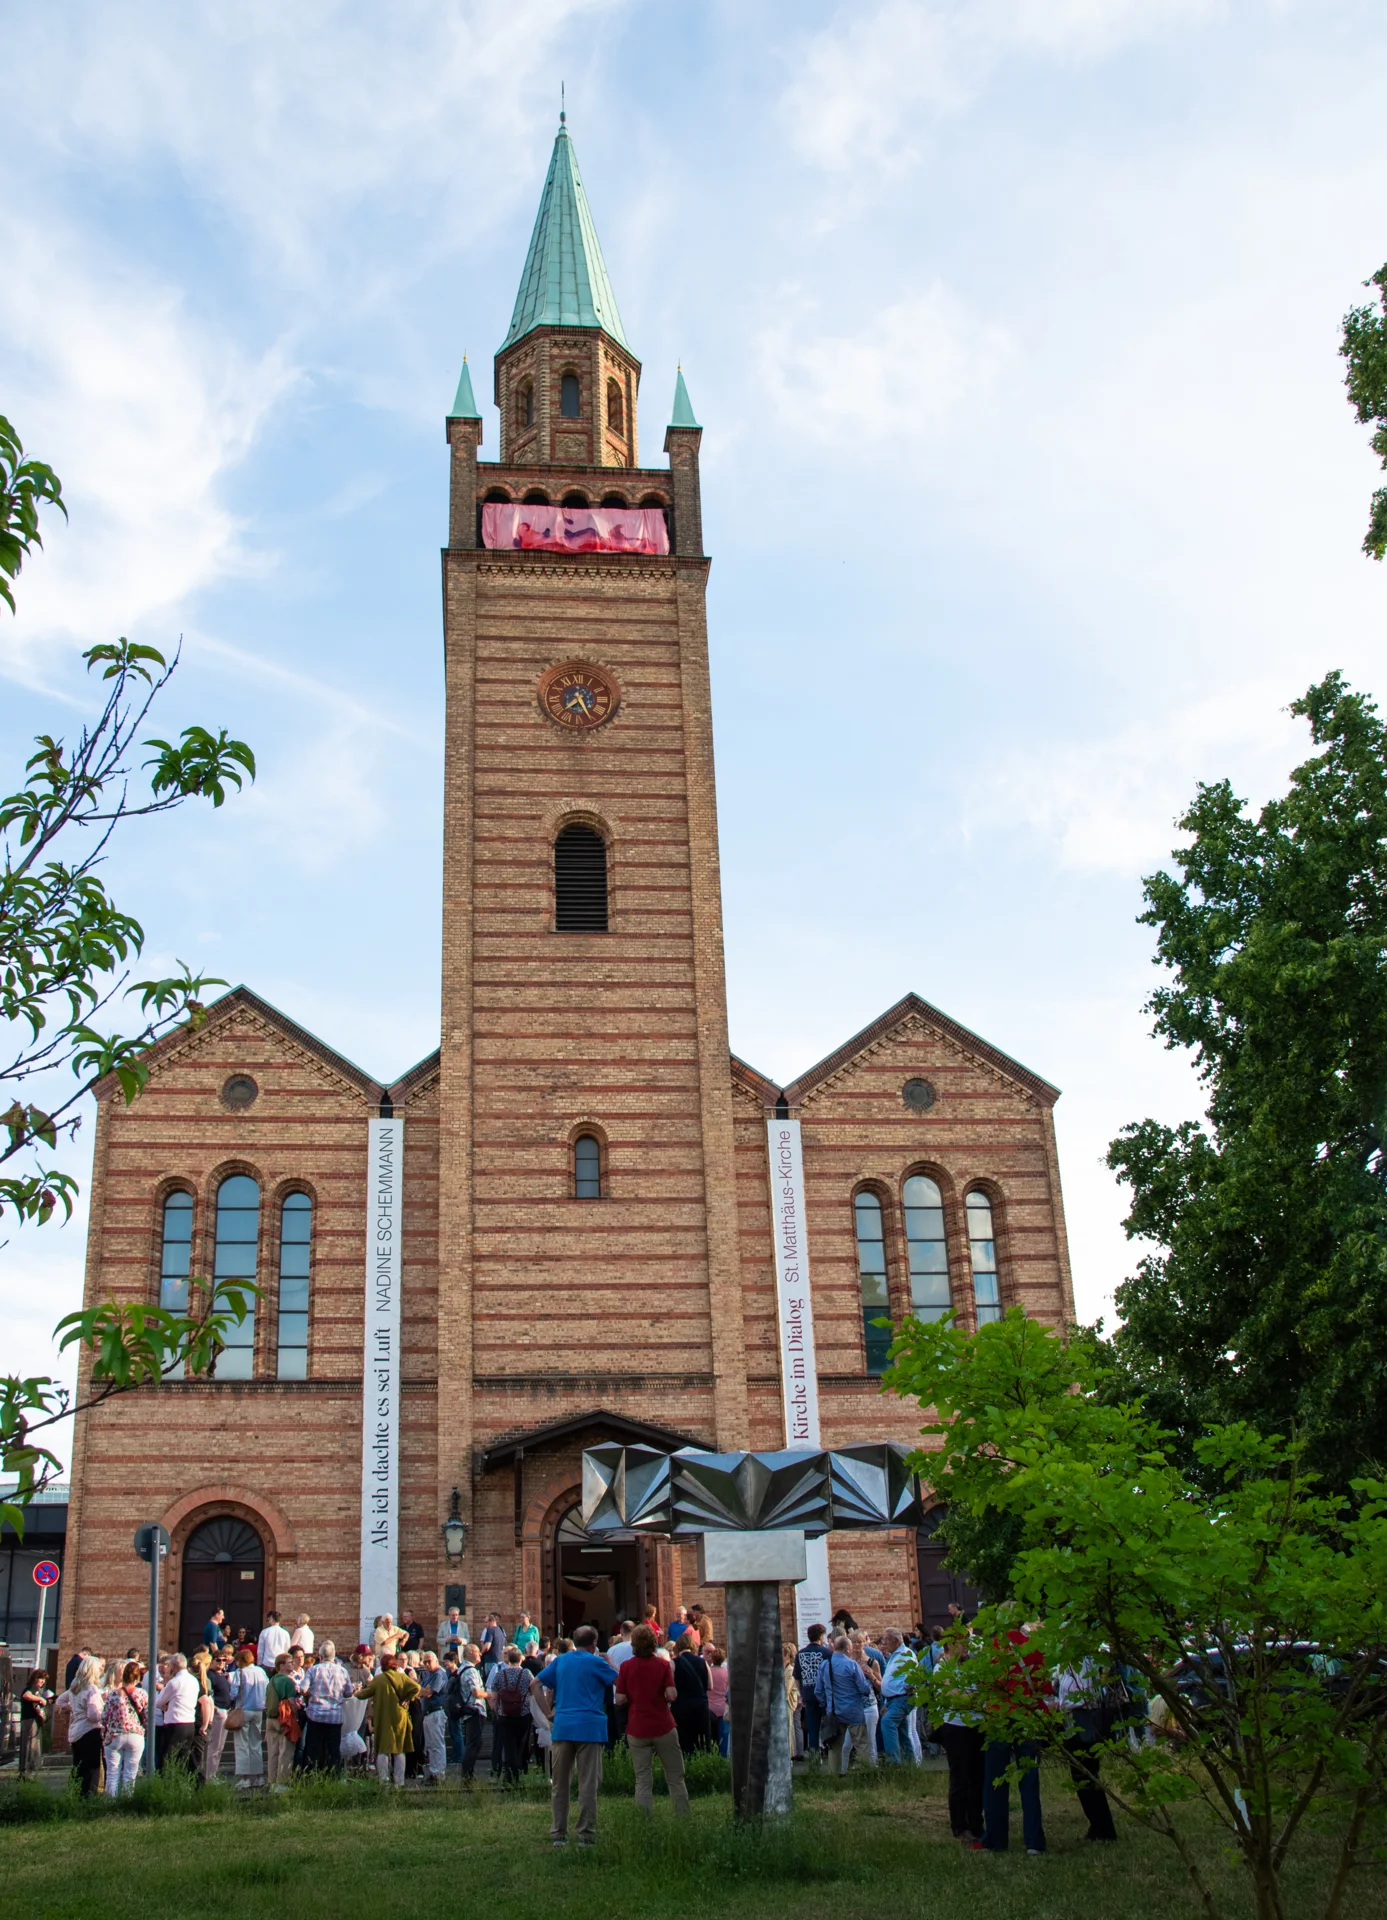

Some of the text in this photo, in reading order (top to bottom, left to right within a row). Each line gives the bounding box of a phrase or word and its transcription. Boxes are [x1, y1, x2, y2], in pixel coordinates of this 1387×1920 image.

[572, 674, 584, 684] XII
[376, 1128, 393, 1312] NADINE SCHEMMANN
[777, 1130, 800, 1283] St. Matthäus-Kirche
[371, 1327, 391, 1550] Als ich dachte es sei Luft
[786, 1298, 810, 1440] Kirche im Dialog
